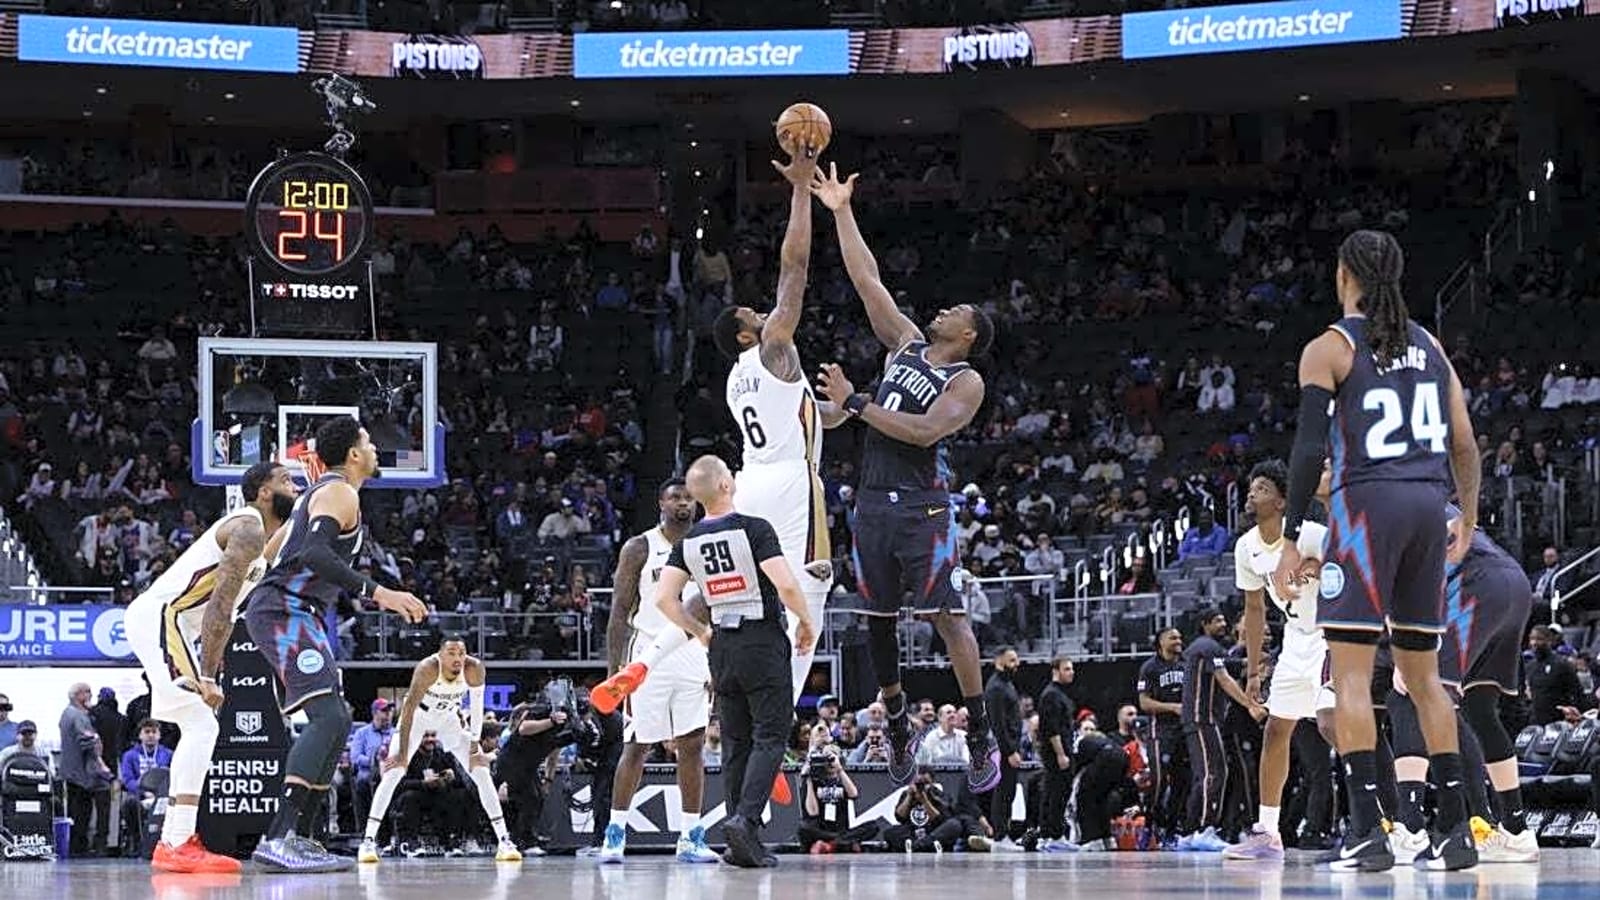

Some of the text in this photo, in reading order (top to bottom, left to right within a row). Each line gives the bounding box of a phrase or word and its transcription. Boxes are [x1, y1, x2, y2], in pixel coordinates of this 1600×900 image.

[1496, 0, 1580, 18] PIST
[1168, 8, 1352, 46] ticketmaster
[65, 25, 252, 61] ticketmaster
[619, 40, 803, 68] ticketmaster
[284, 181, 348, 209] 12:00
[279, 211, 343, 261] 24
[288, 284, 358, 299] TISSOT
[883, 364, 938, 406] DETROIT
[742, 406, 767, 448] 6
[1363, 382, 1447, 458] 24
[700, 540, 735, 575] 39
[209, 760, 279, 776] HENRY
[209, 779, 264, 795] FORD
[13, 834, 46, 846] Little
